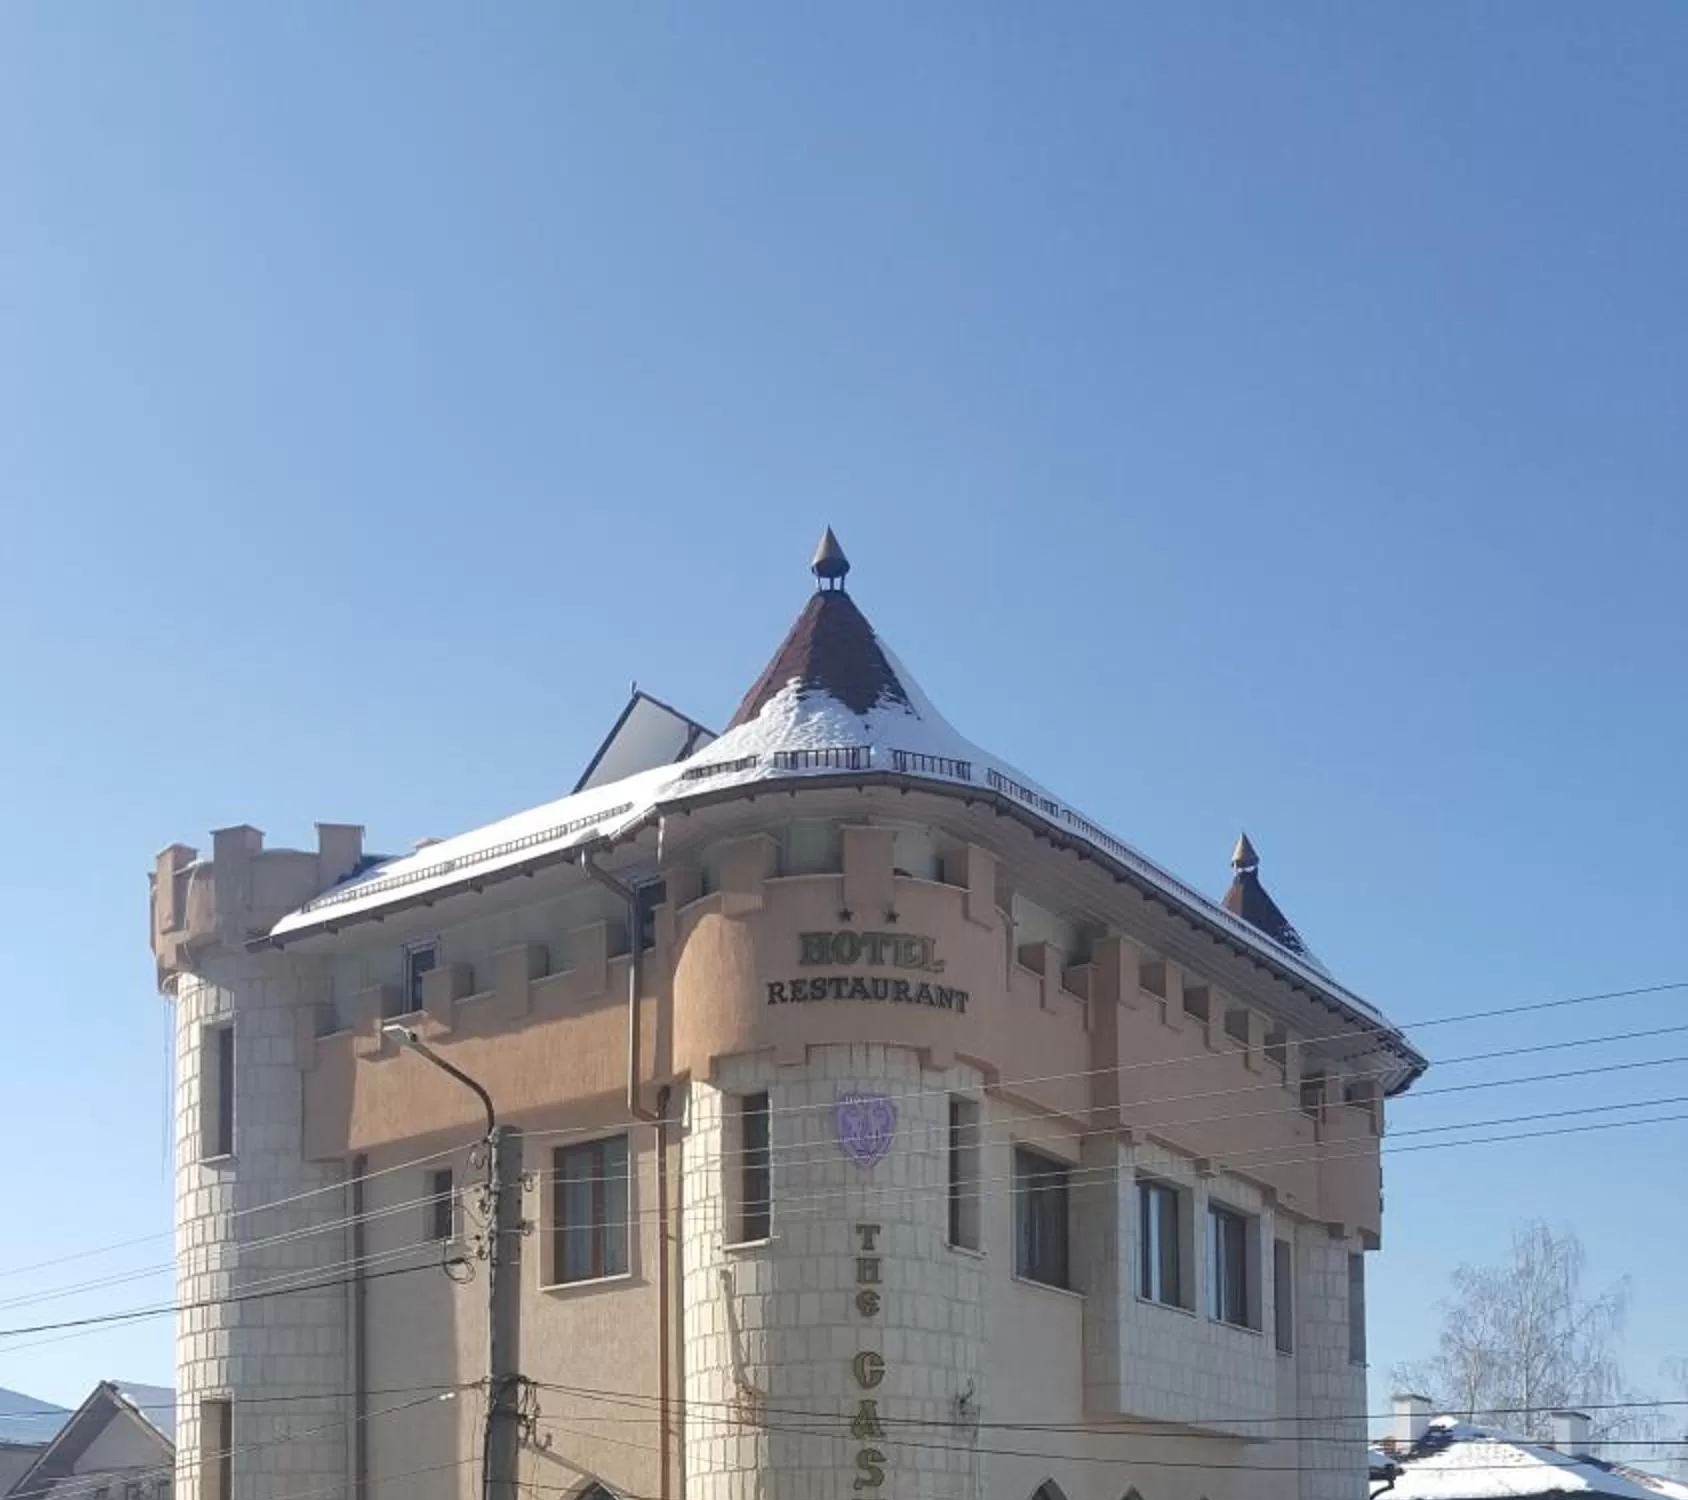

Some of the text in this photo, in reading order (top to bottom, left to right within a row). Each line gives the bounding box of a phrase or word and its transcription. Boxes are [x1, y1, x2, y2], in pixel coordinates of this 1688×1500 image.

[798, 930, 944, 973] HOTEL
[767, 976, 969, 1014] RESTAURANT
[855, 1223, 882, 1317] THE
